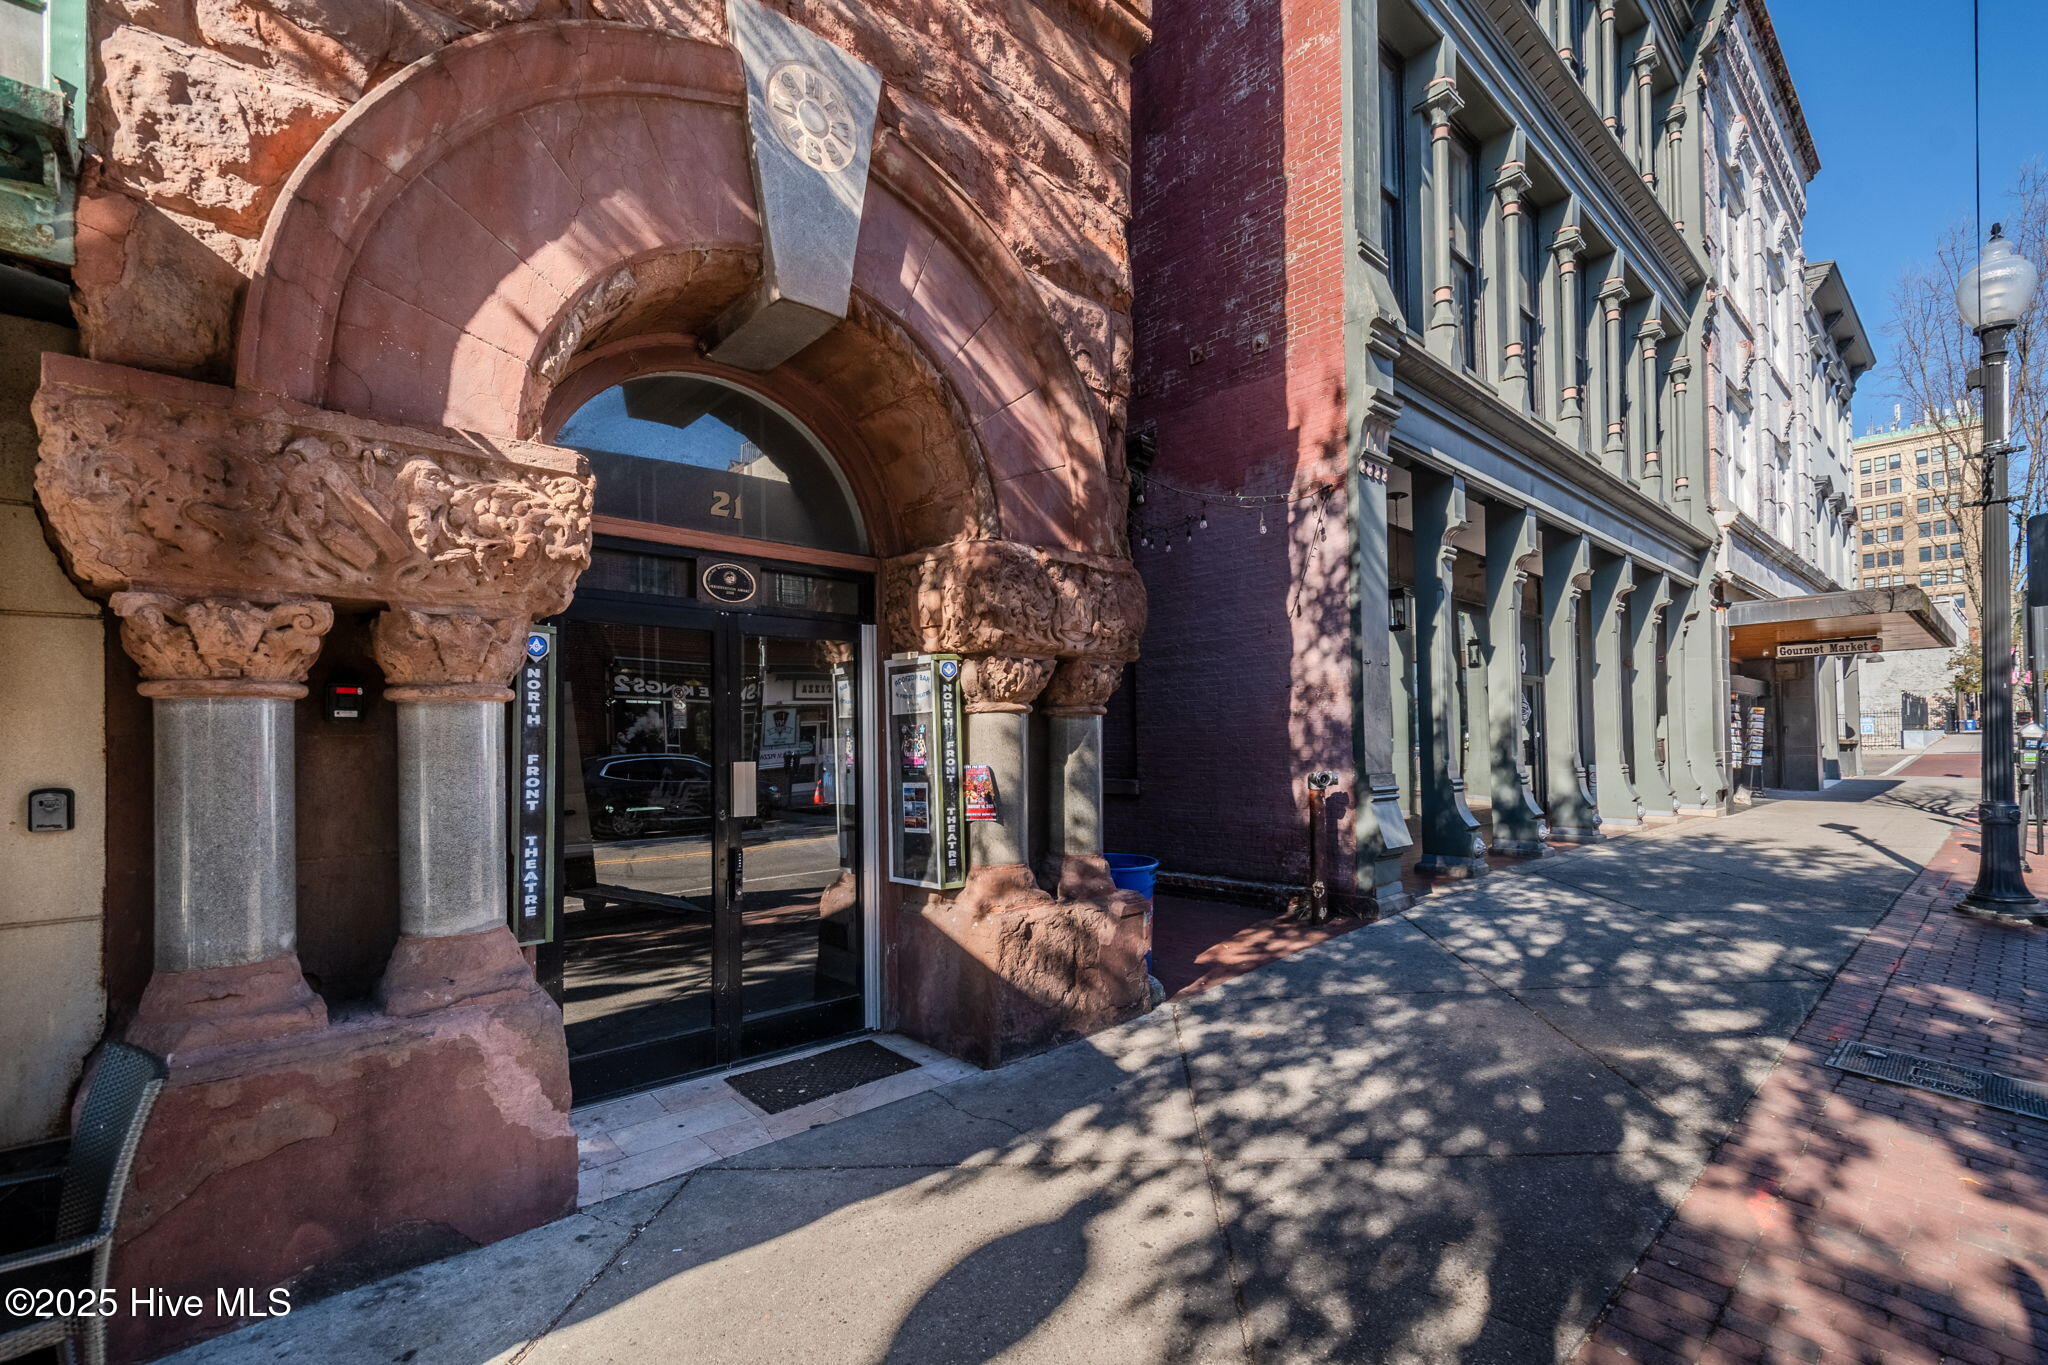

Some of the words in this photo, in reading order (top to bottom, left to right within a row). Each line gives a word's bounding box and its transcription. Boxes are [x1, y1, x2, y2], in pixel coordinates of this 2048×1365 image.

[710, 490, 743, 520] 21
[1779, 645, 1824, 656] Gourmet
[1829, 641, 1869, 653] Market
[526, 667, 541, 726] NORTH
[942, 684, 953, 726] NORTH
[525, 754, 541, 811] FRONT
[945, 741, 957, 782] FRONT
[946, 808, 958, 867] THEATRE
[523, 836, 539, 917] THEATRE
